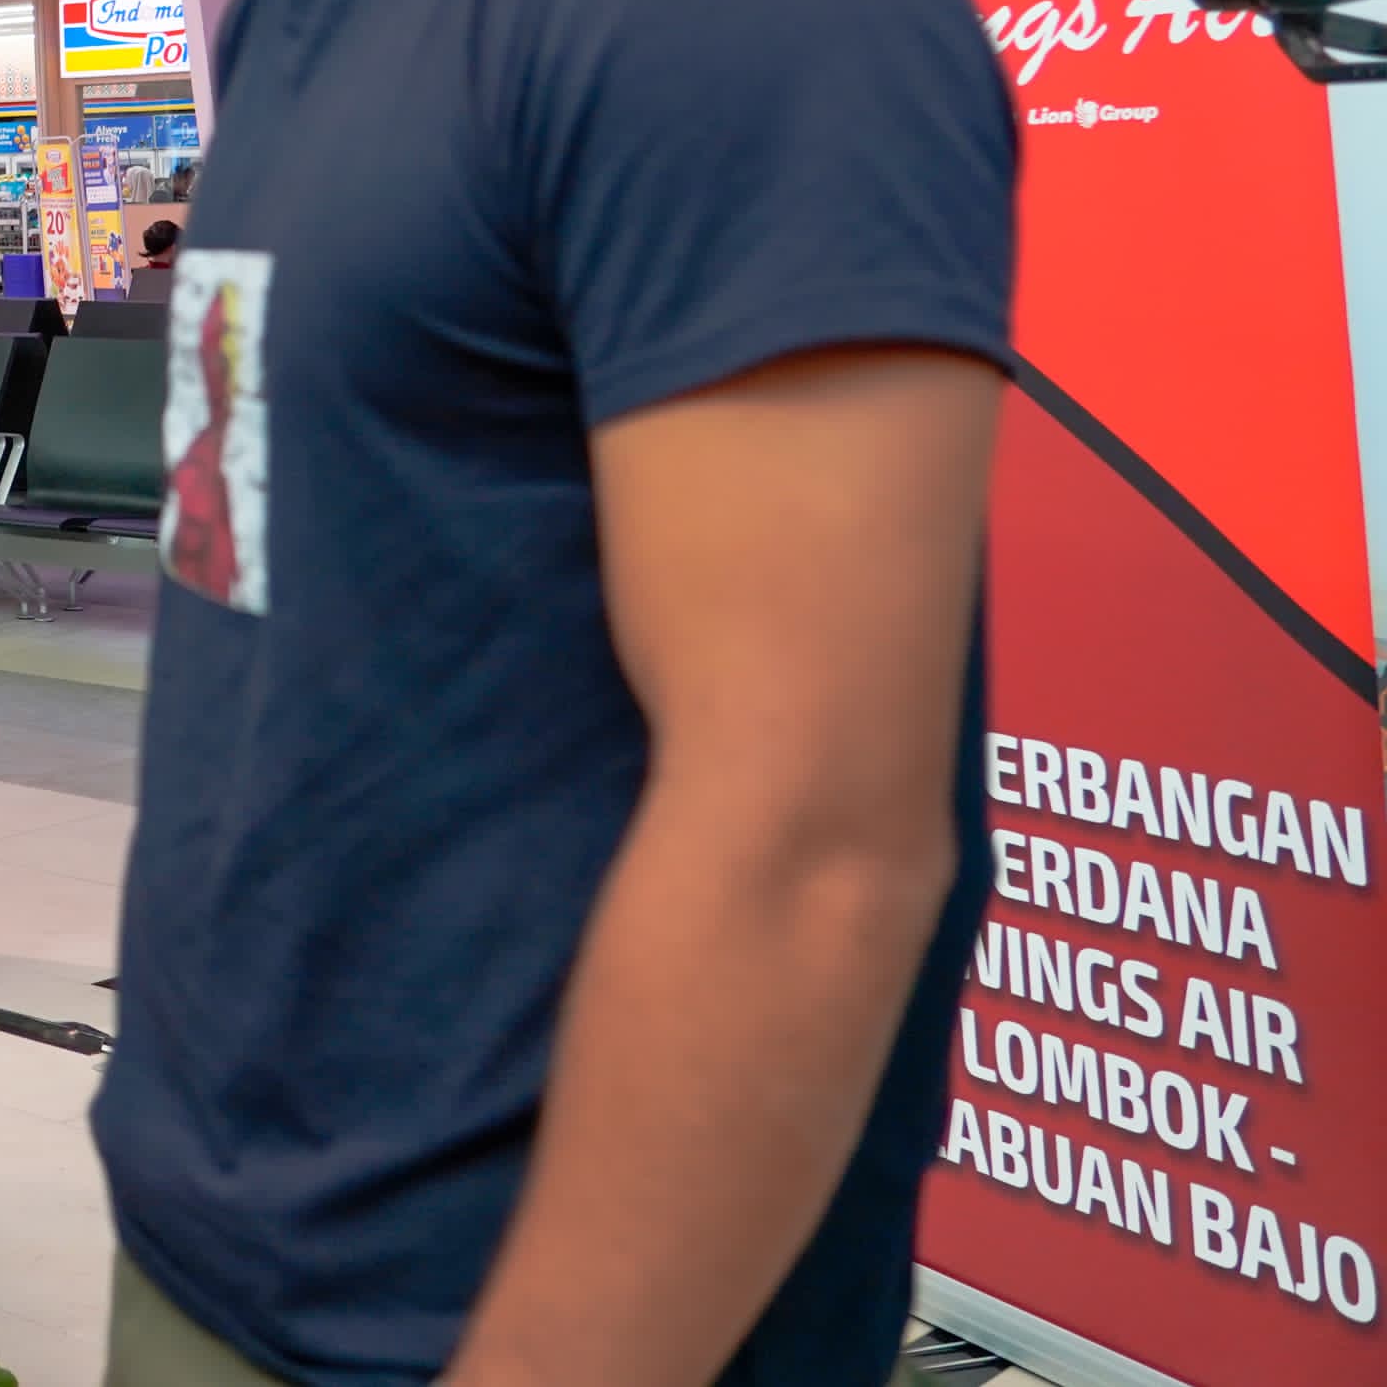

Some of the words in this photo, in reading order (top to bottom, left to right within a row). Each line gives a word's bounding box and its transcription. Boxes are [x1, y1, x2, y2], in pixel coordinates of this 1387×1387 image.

[1028, 108, 1072, 125] Lion
[1099, 105, 1159, 124] Group
[960, 1006, 1255, 1173] LOMBOK
[1270, 1146, 1297, 1166] -
[1179, 976, 1303, 1085] AIR
[939, 1098, 1172, 1246] ABUAN
[1190, 1182, 1378, 1323] BAJO
